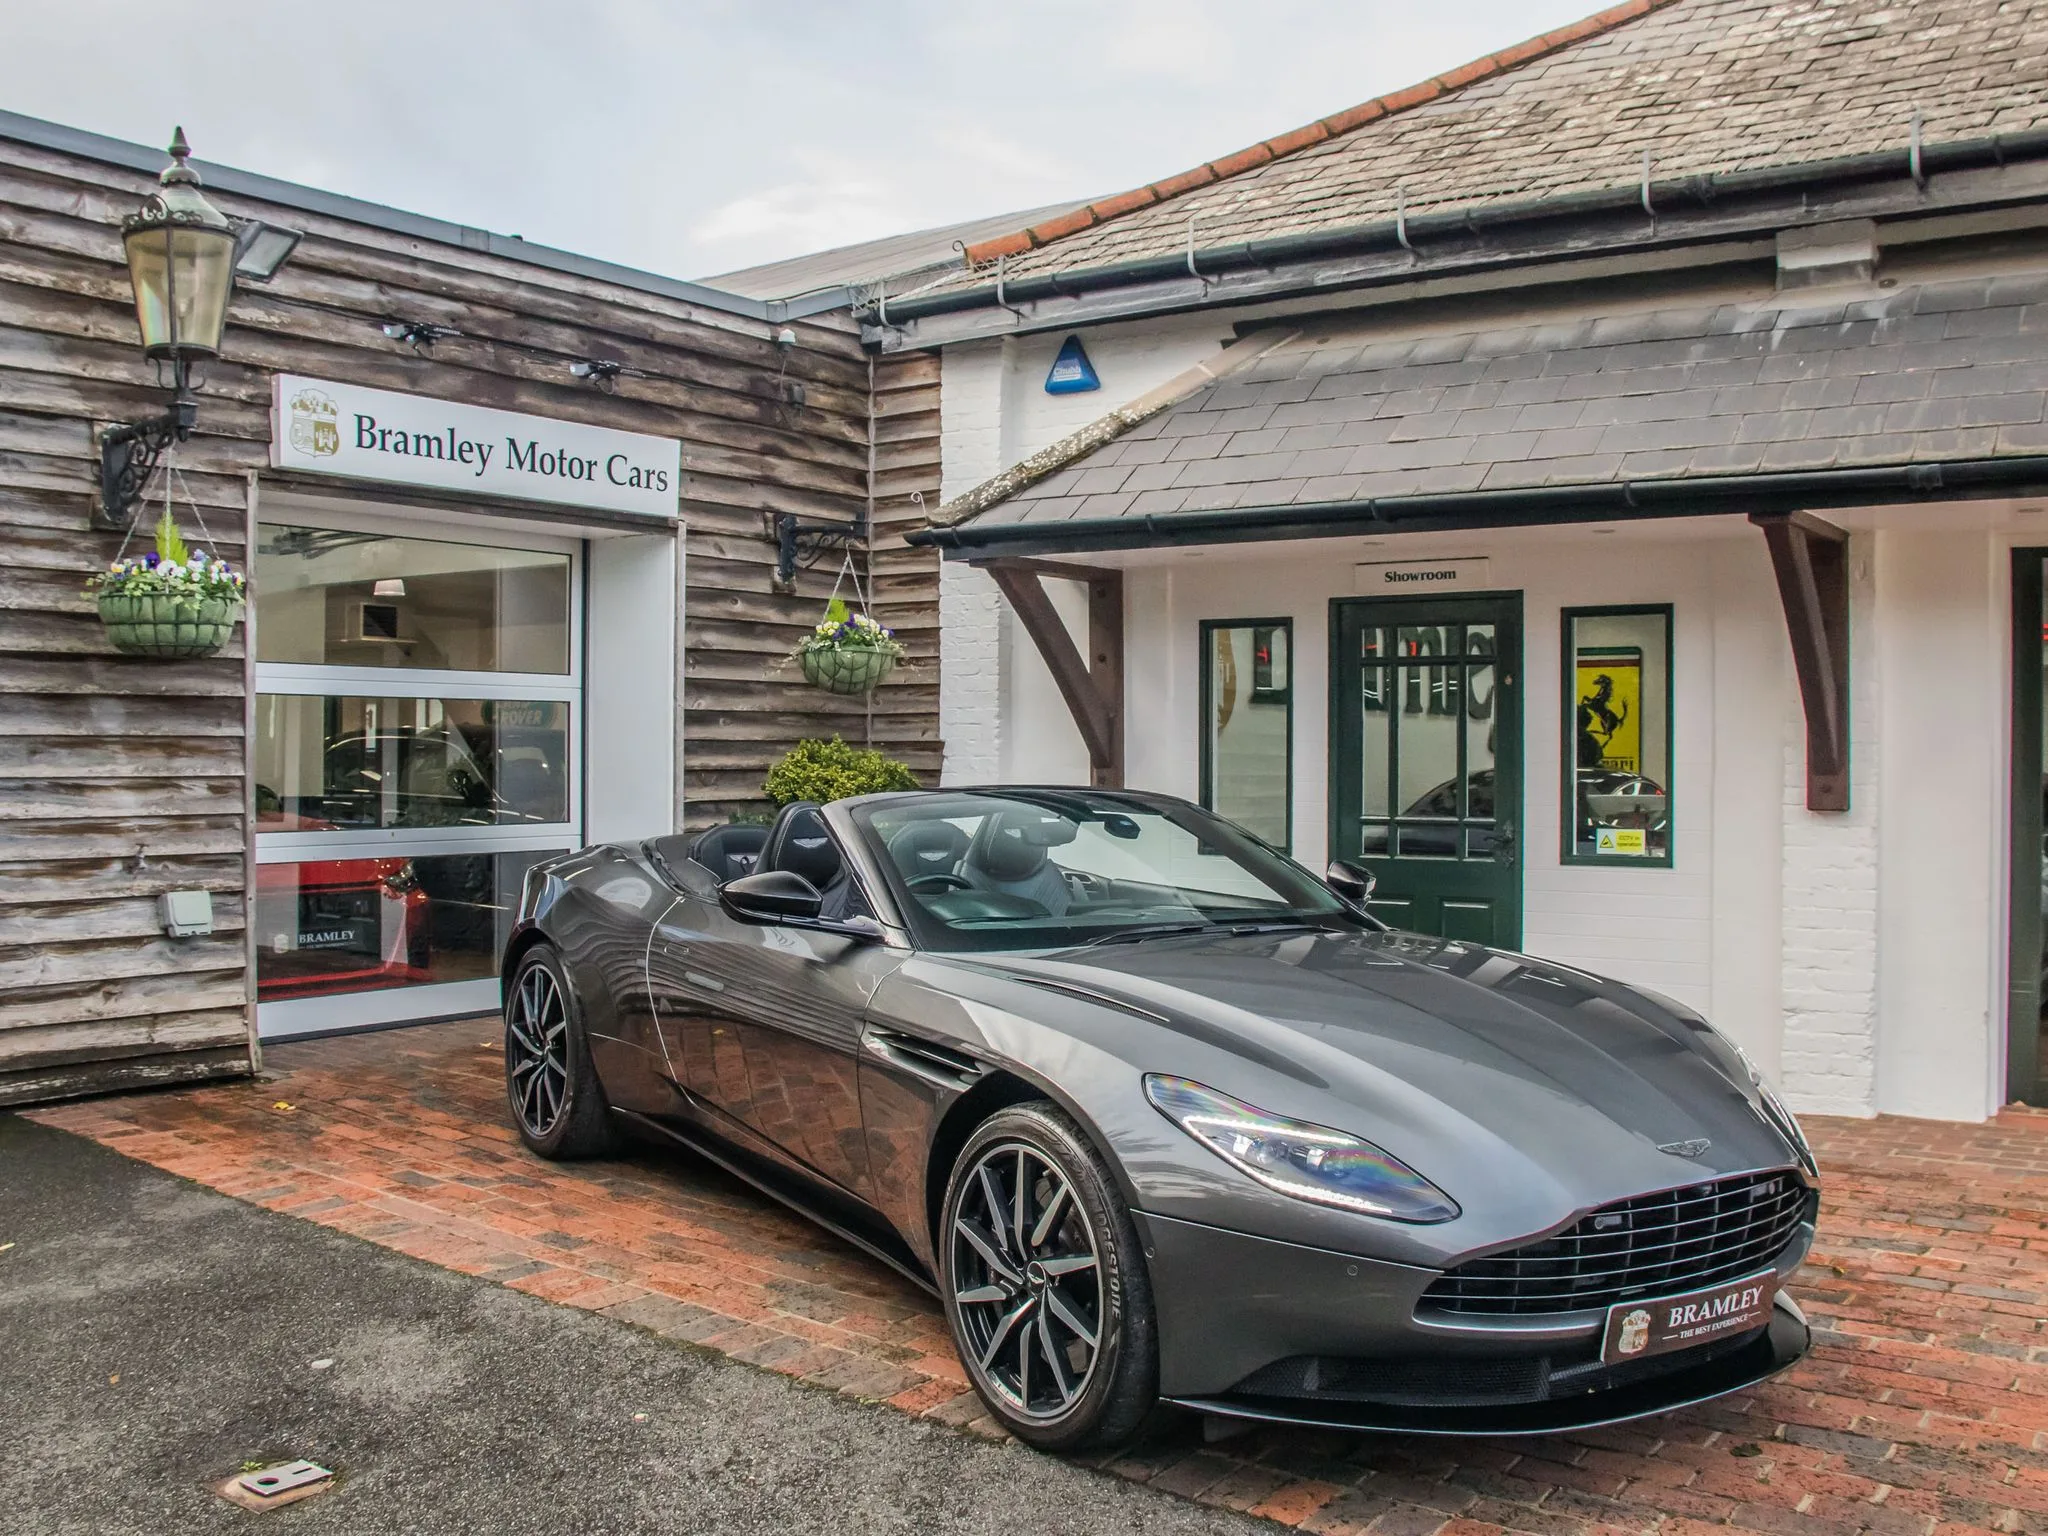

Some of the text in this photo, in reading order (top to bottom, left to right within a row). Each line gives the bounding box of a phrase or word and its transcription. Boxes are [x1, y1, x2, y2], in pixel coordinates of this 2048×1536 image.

[353, 413, 669, 492] Bramley Motor Cars
[1384, 570, 1456, 583] Showroom
[299, 930, 355, 944] BRAMLEY
[1668, 1285, 1764, 1328] BRAMLEY
[1680, 1329, 1694, 1339] THE
[1695, 1324, 1711, 1336] BEST
